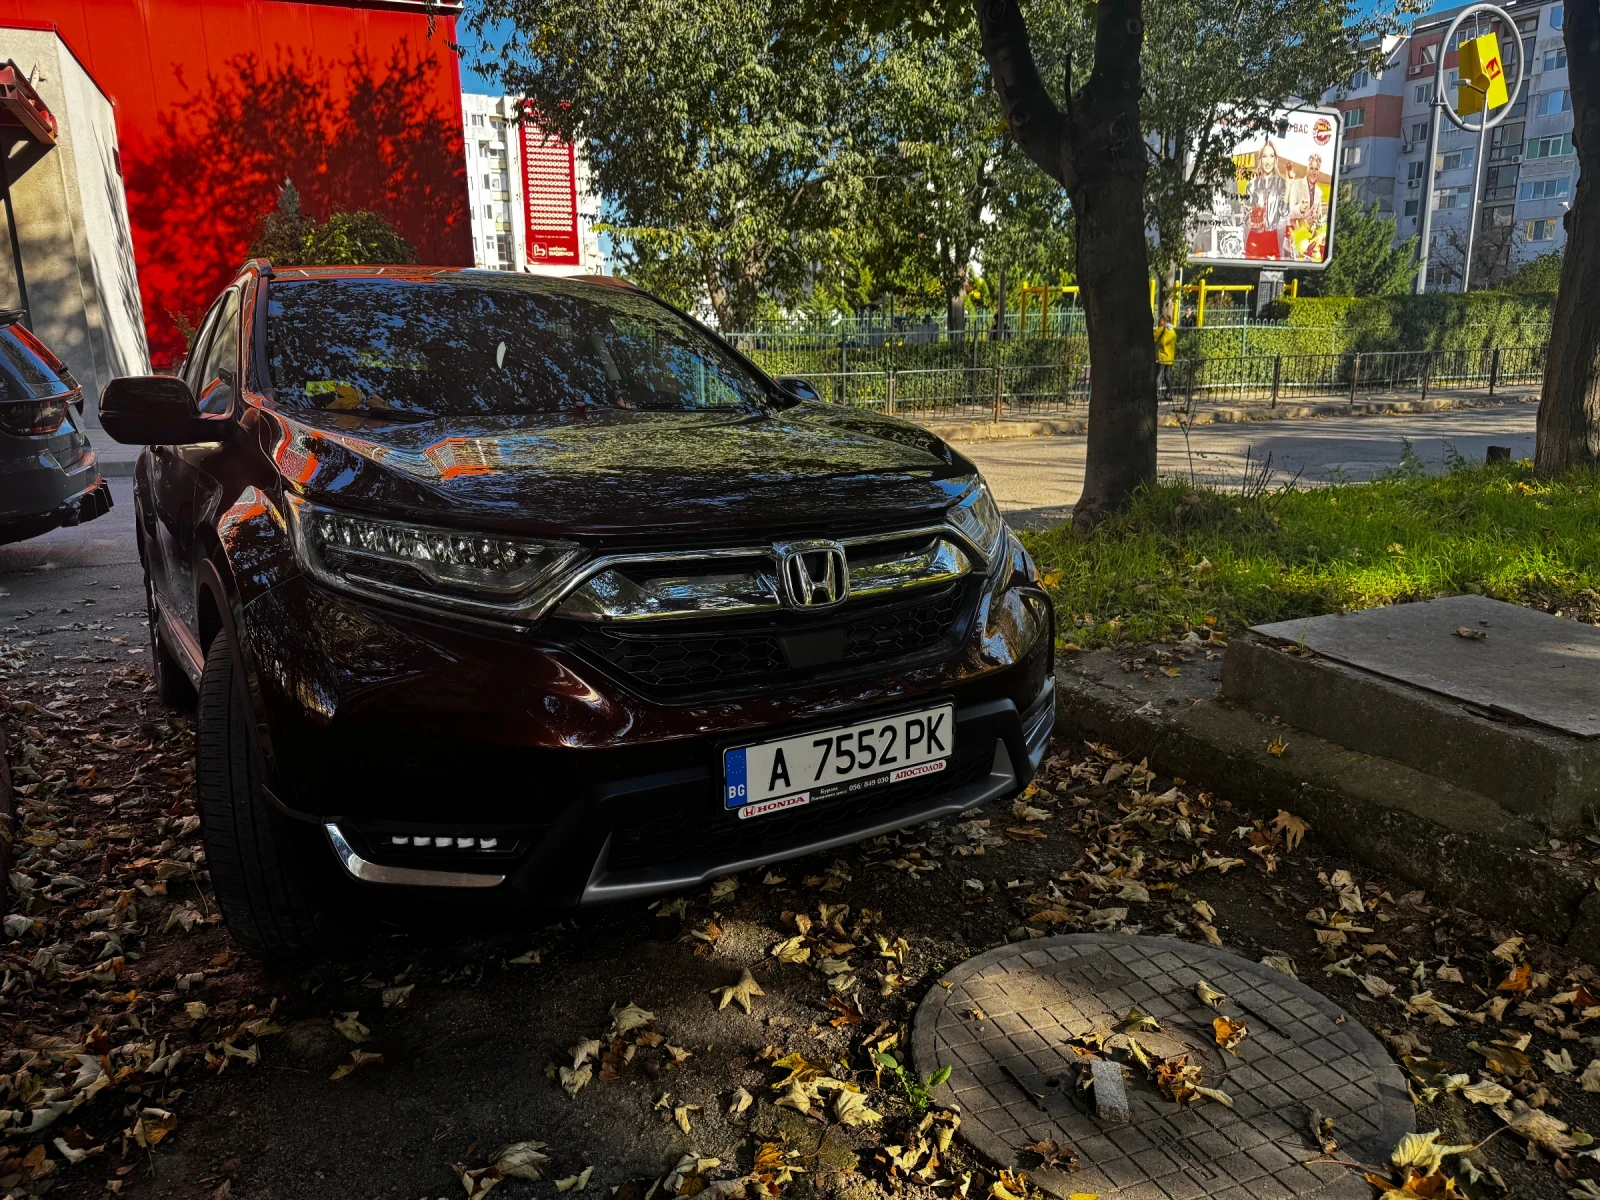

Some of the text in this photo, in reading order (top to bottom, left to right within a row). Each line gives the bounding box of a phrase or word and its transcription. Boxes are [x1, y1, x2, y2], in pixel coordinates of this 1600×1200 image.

[768, 713, 946, 792] A 7552 PK
[895, 762, 944, 780] АПОСТОЛОВ
[863, 779, 876, 788] 849
[877, 776, 889, 785] 030
[728, 784, 746, 799] BG
[757, 796, 806, 813] HONDA
